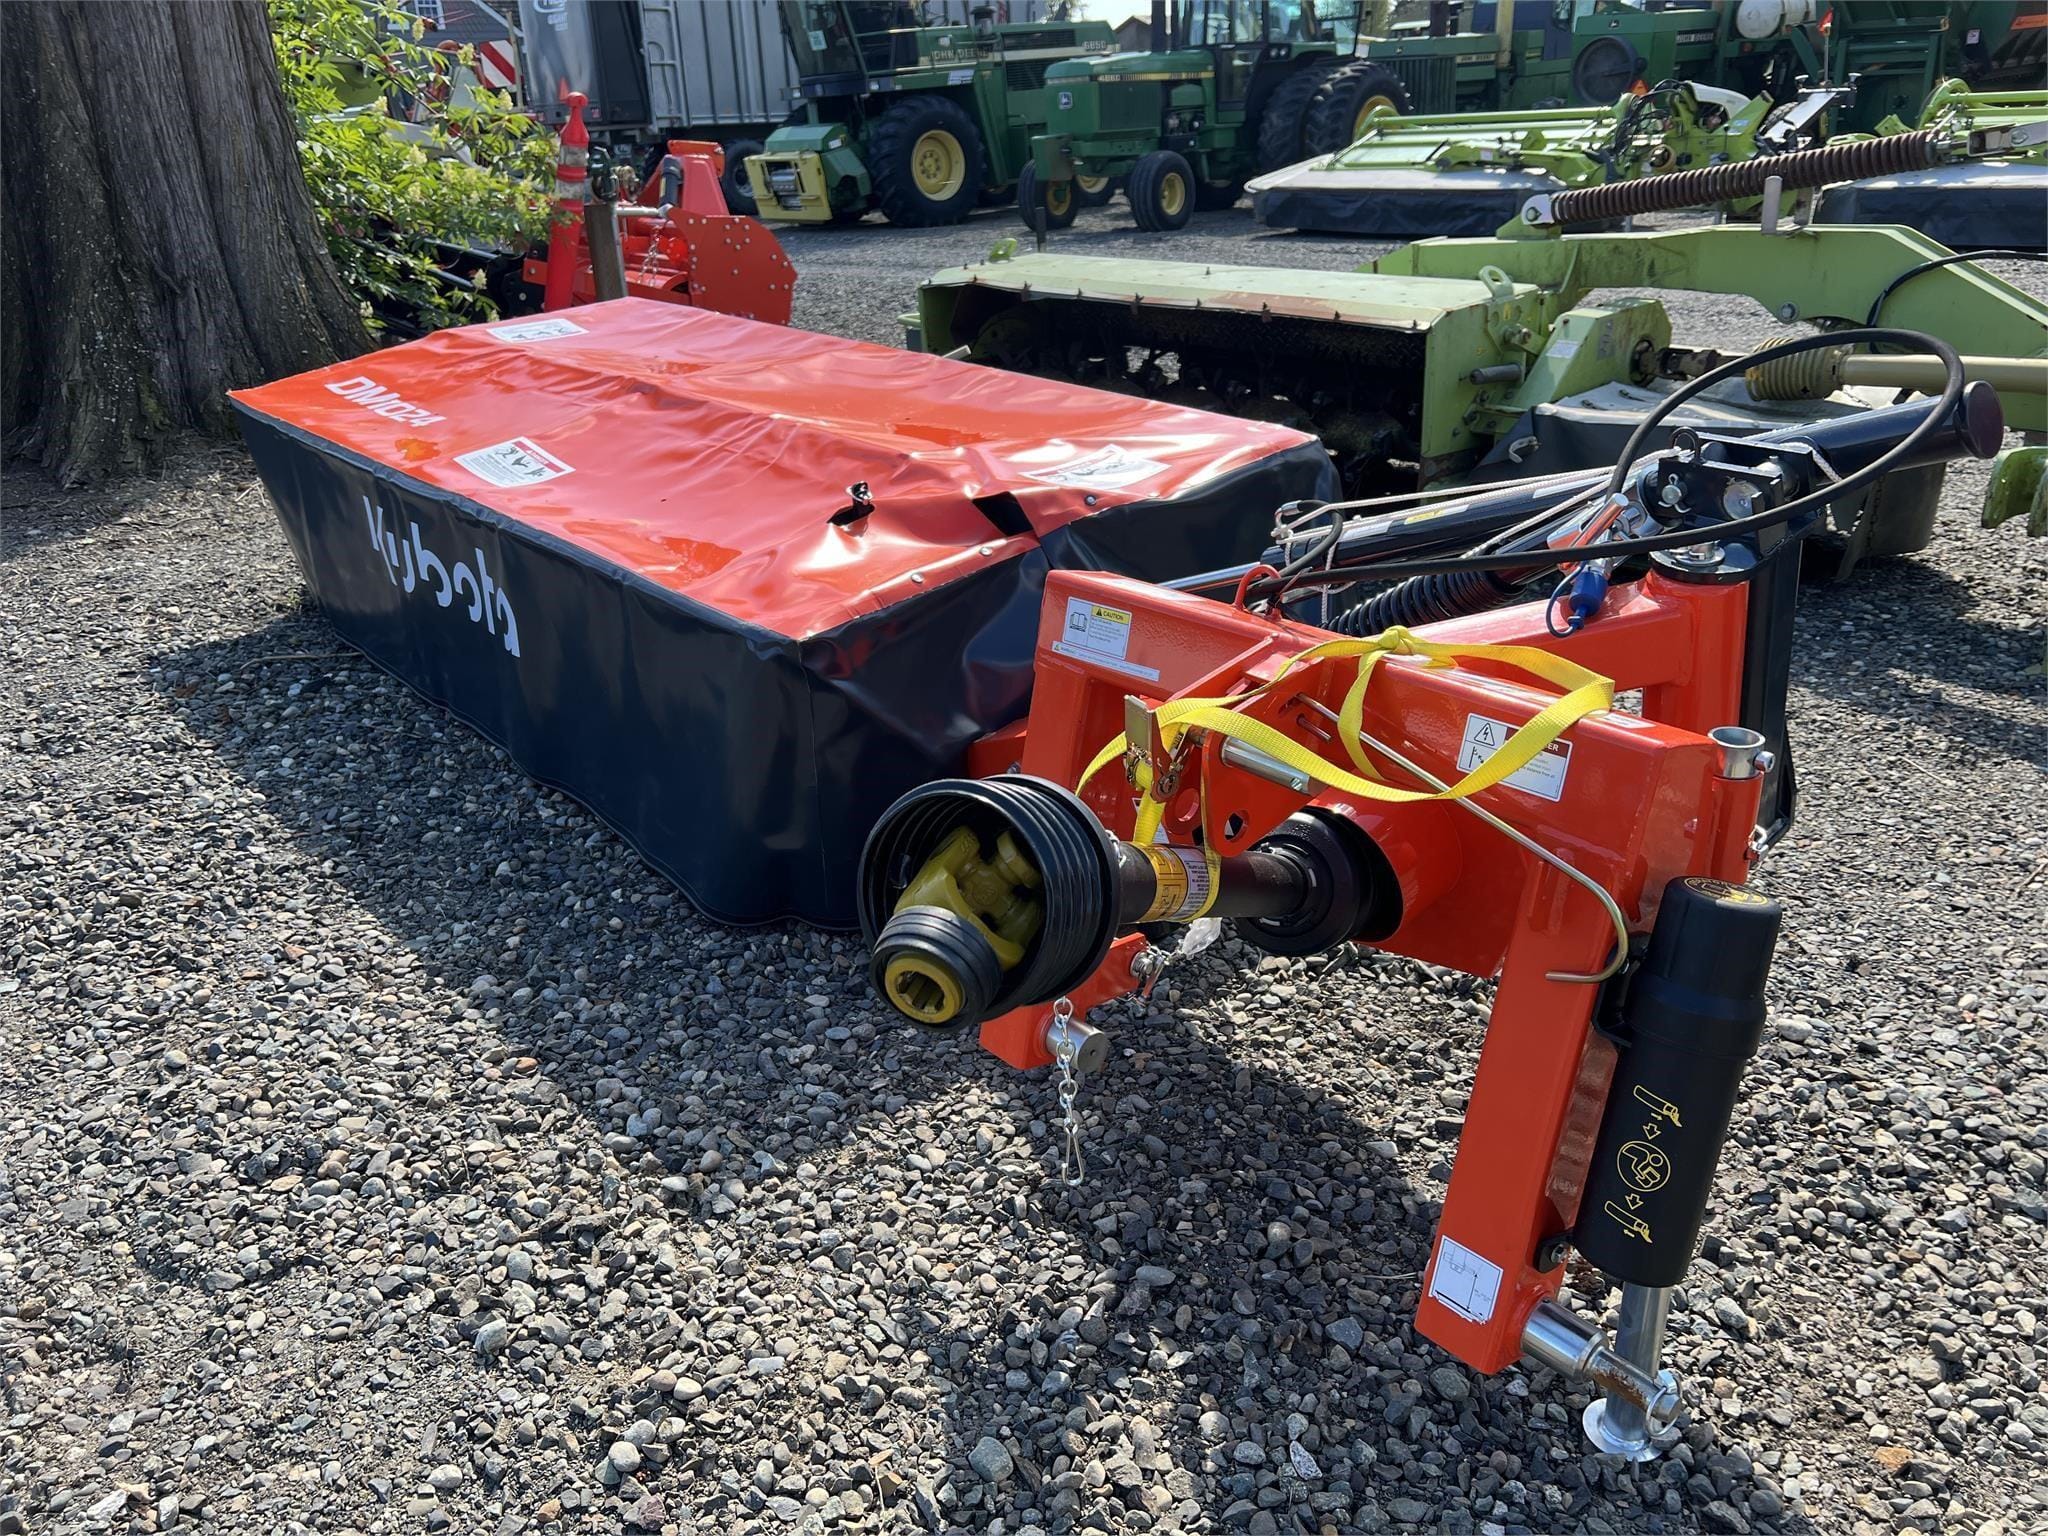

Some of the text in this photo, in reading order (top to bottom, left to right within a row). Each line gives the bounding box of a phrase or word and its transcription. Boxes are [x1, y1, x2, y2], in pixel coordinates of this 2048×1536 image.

[324, 376, 447, 427] DM1024
[363, 495, 520, 657] Kubota
[1103, 610, 1124, 621] CAUTION
